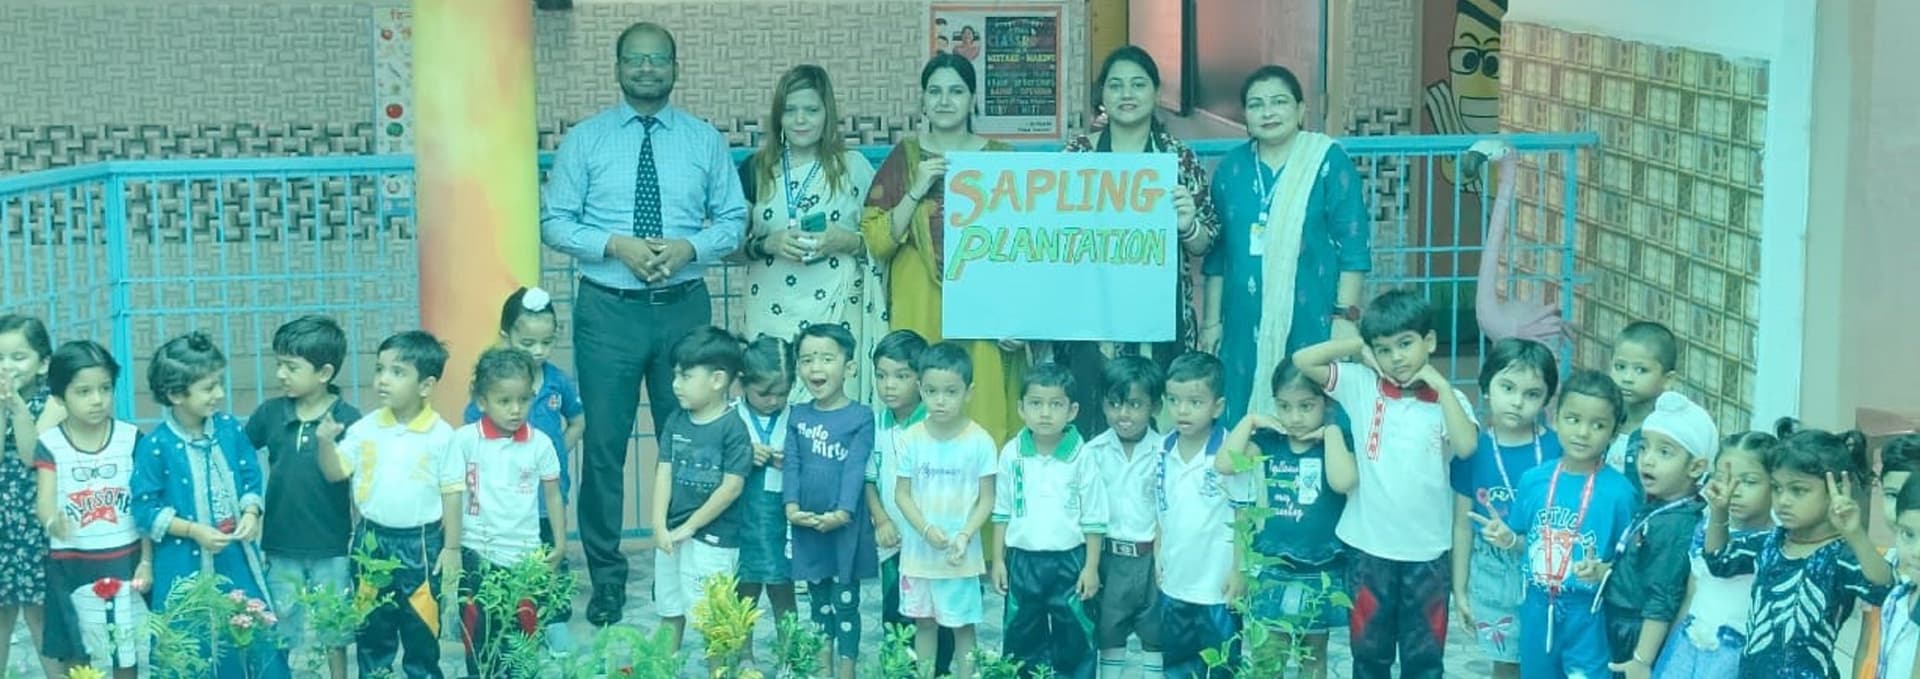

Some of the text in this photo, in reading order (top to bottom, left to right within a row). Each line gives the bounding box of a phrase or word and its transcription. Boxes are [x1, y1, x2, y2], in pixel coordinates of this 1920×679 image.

[949, 168, 1166, 227] SAPLING
[945, 225, 1167, 280] PLANTATION
[797, 422, 828, 440] Hello
[811, 439, 849, 461] Kitty
